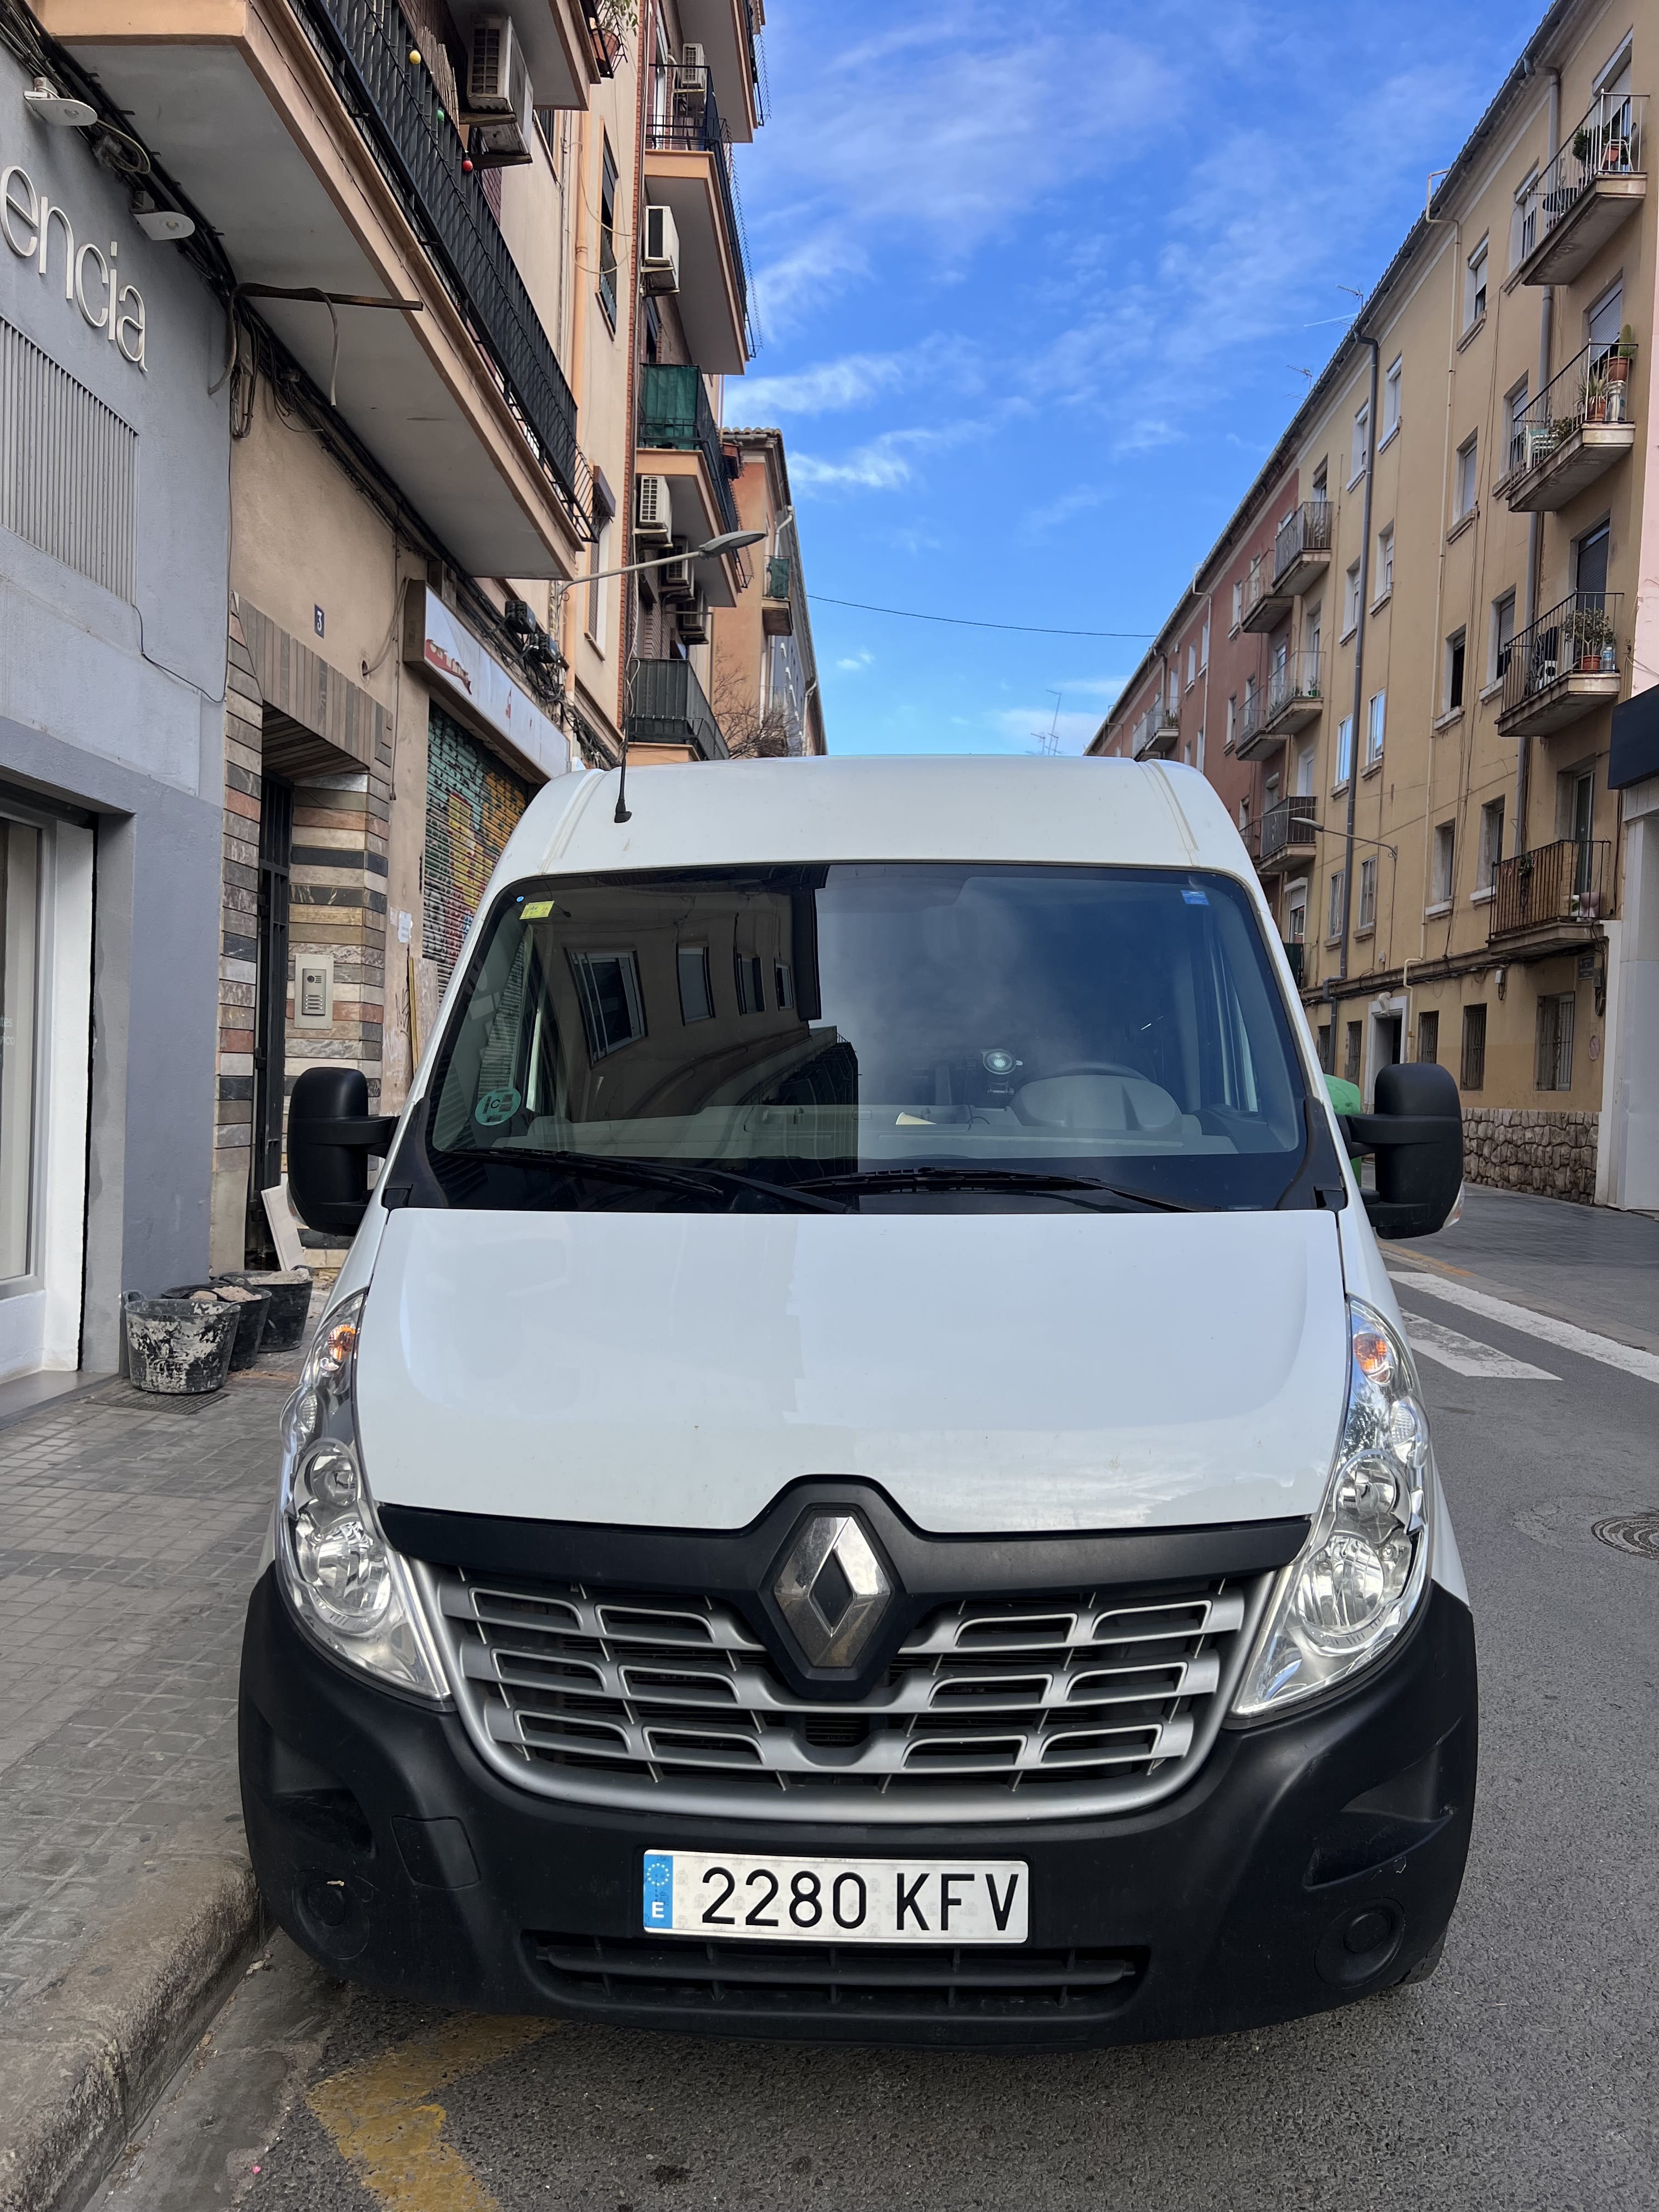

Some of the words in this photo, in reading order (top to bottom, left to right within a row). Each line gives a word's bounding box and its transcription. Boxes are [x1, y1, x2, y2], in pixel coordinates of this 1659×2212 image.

[0, 166, 148, 372] encia
[317, 611, 322, 631] 3
[0, 1014, 13, 1028] tes
[491, 1099, 500, 1108] C
[702, 1867, 867, 1929] 2280
[896, 1872, 1019, 1931] KFV
[652, 1901, 664, 1918] E
